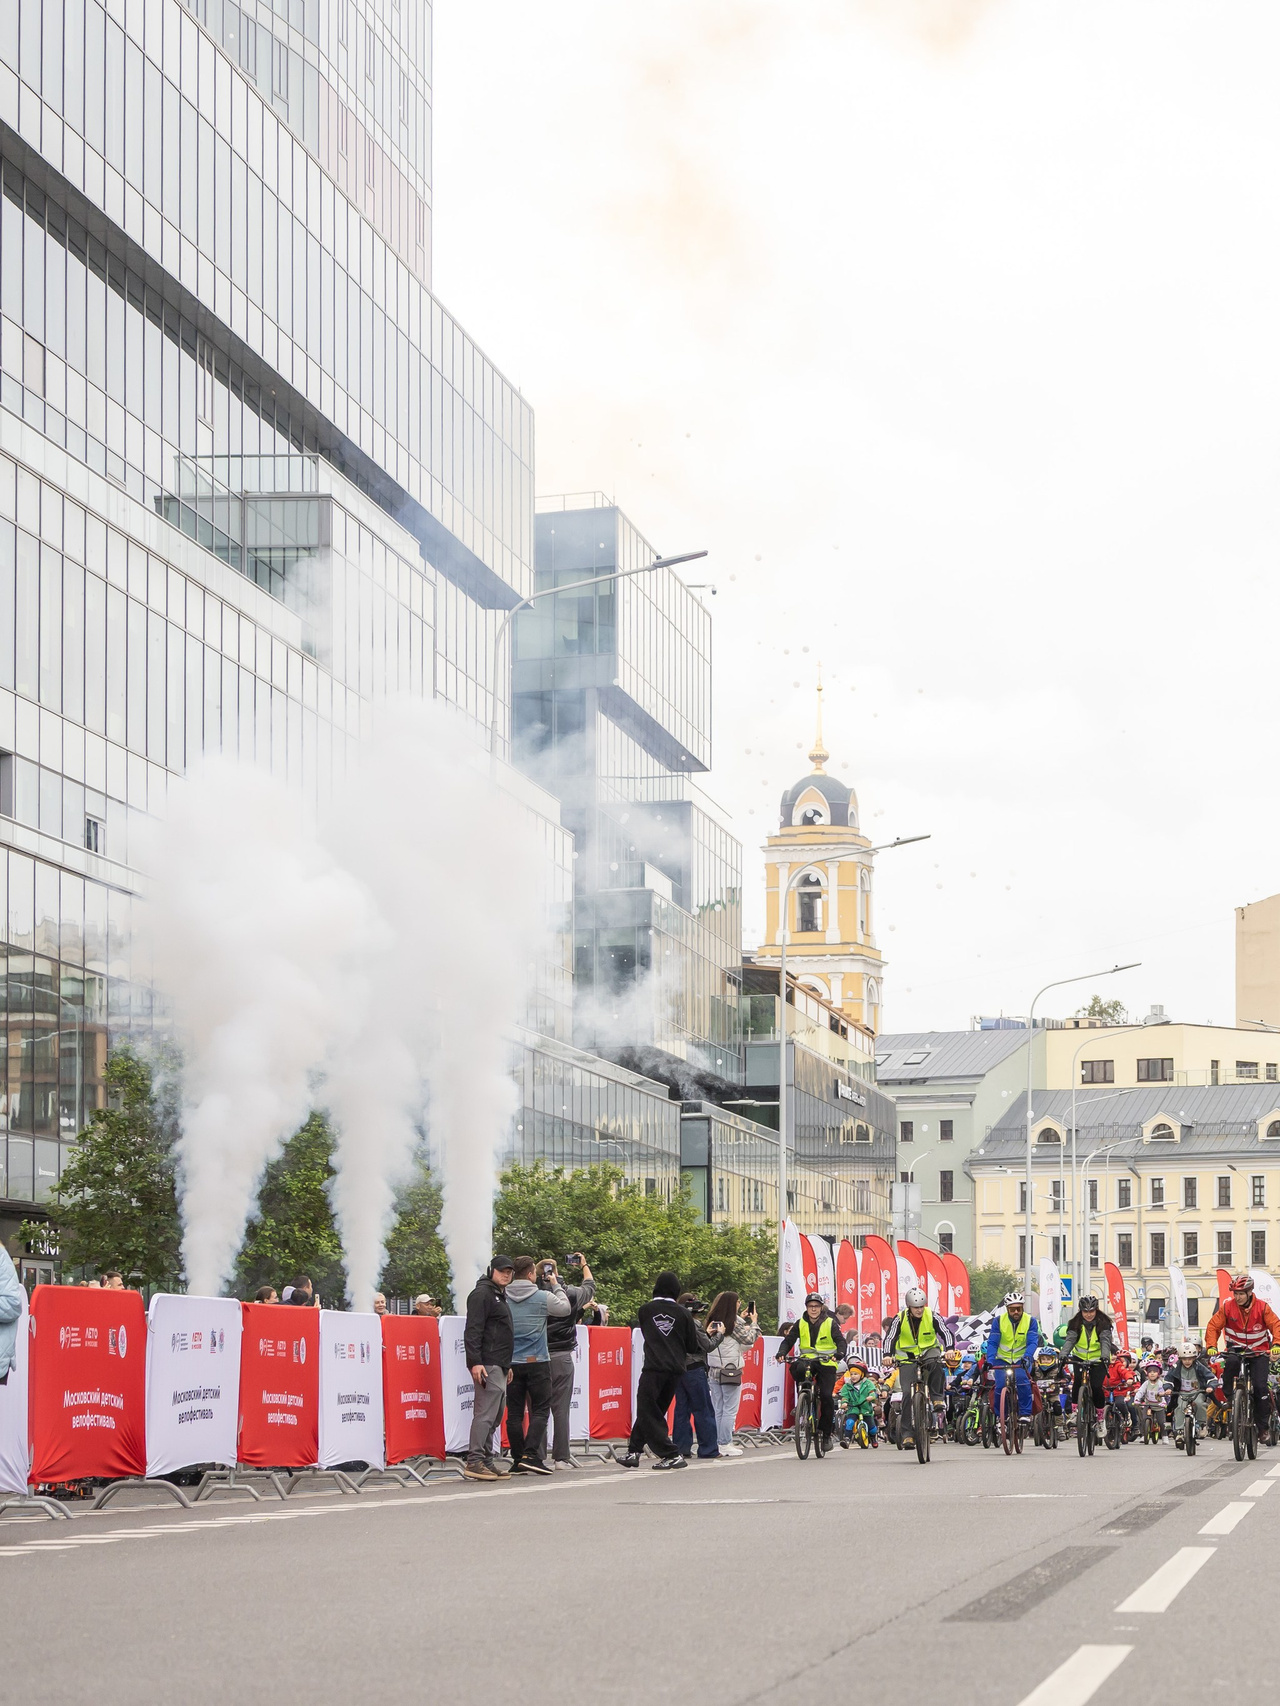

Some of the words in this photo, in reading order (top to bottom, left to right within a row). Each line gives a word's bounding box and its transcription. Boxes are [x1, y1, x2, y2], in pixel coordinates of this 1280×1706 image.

[64, 1388, 100, 1408] Московский
[100, 1394, 124, 1410] детский
[172, 1386, 202, 1406] Московский
[202, 1386, 220, 1401] детский
[262, 1390, 287, 1404] Московский
[287, 1394, 304, 1407] детский
[72, 1410, 116, 1430] велофестиваль
[178, 1406, 214, 1424] велофестиваль
[268, 1409, 298, 1426] велофестиваль
